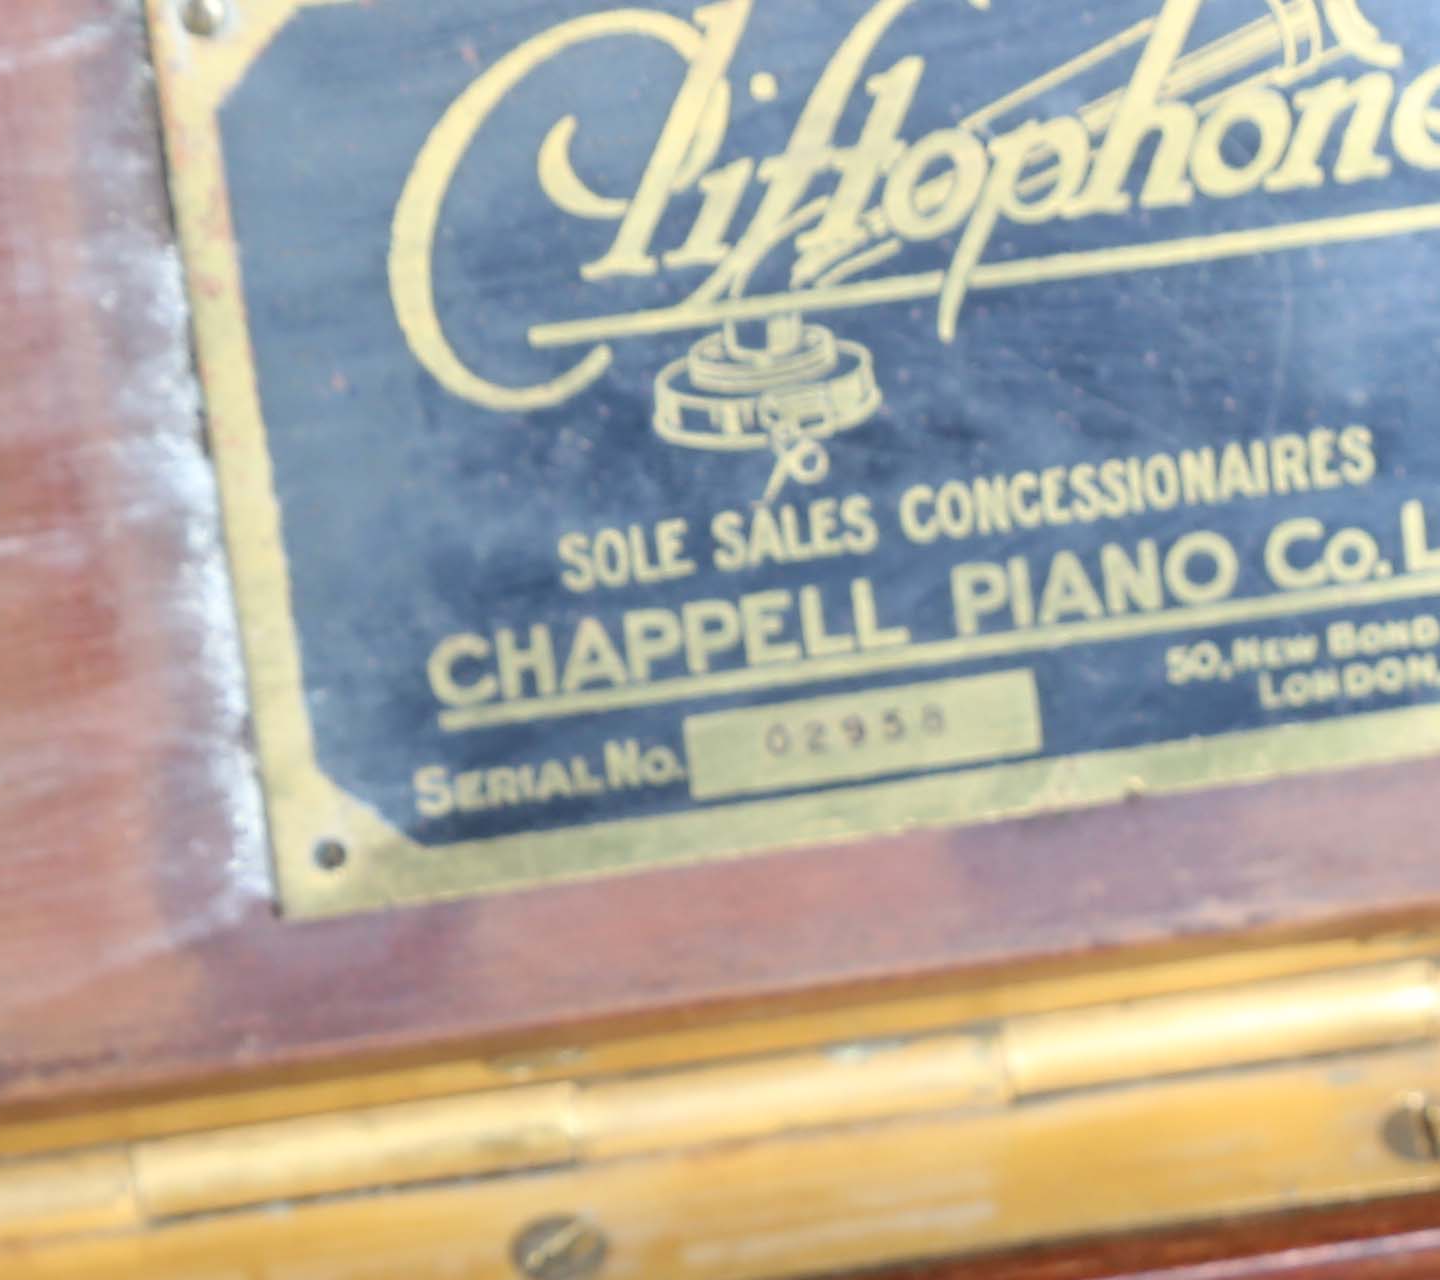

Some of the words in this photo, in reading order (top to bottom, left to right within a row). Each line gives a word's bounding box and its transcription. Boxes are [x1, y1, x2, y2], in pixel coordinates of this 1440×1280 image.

[558, 518, 696, 592] SOLE
[712, 495, 879, 571] SALES
[900, 425, 1376, 544] CONCESSIONAIRES
[426, 578, 909, 706] CHAPPELL
[951, 530, 1239, 637] PIANO
